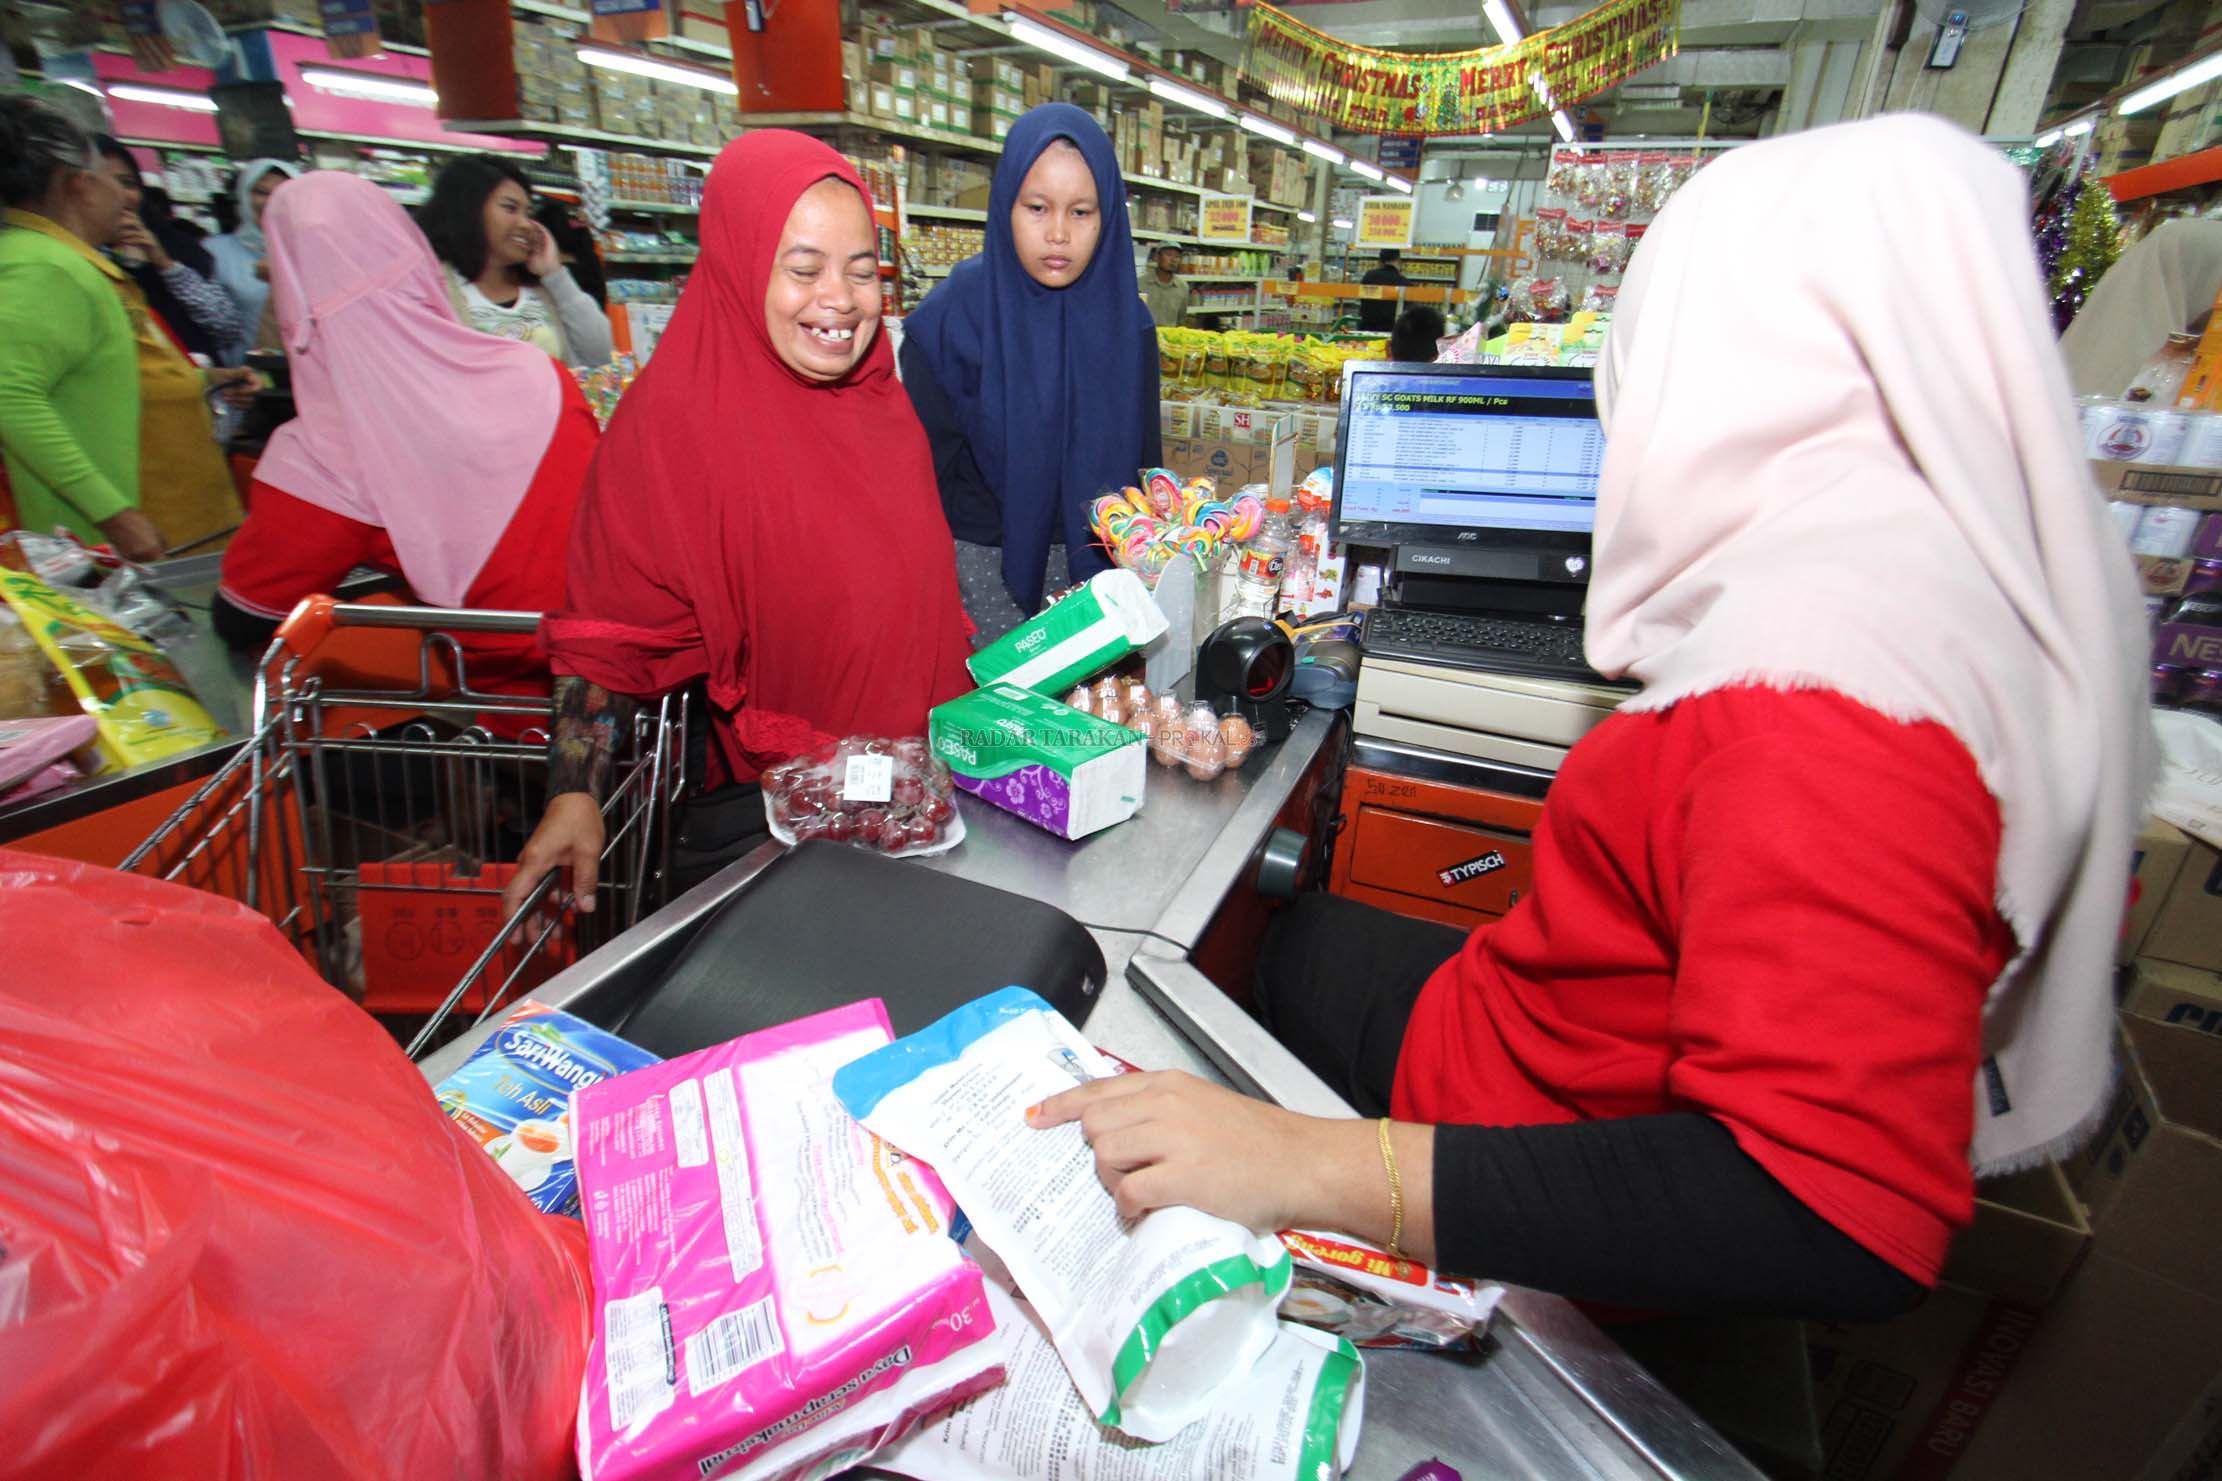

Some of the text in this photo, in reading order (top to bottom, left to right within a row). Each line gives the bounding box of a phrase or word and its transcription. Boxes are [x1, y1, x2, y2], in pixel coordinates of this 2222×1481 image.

[1459, 57, 1529, 97] MERRY
[1393, 394, 1422, 403] GOATS
[1423, 395, 1445, 404] MILK
[1458, 396, 1485, 405] 900ML
[1411, 554, 1451, 565] CIKACHI
[1014, 628, 1047, 654] PASEO
[2168, 632, 2222, 663] NE
[935, 736, 977, 766] PASEO
[517, 1089, 552, 1115] Asli
[1284, 1234, 1392, 1277] Mi goreng
[949, 1305, 974, 1333] 30
[860, 1344, 912, 1383] Daya
[799, 1378, 859, 1418] serap
[1926, 1398, 1982, 1457] BARU
